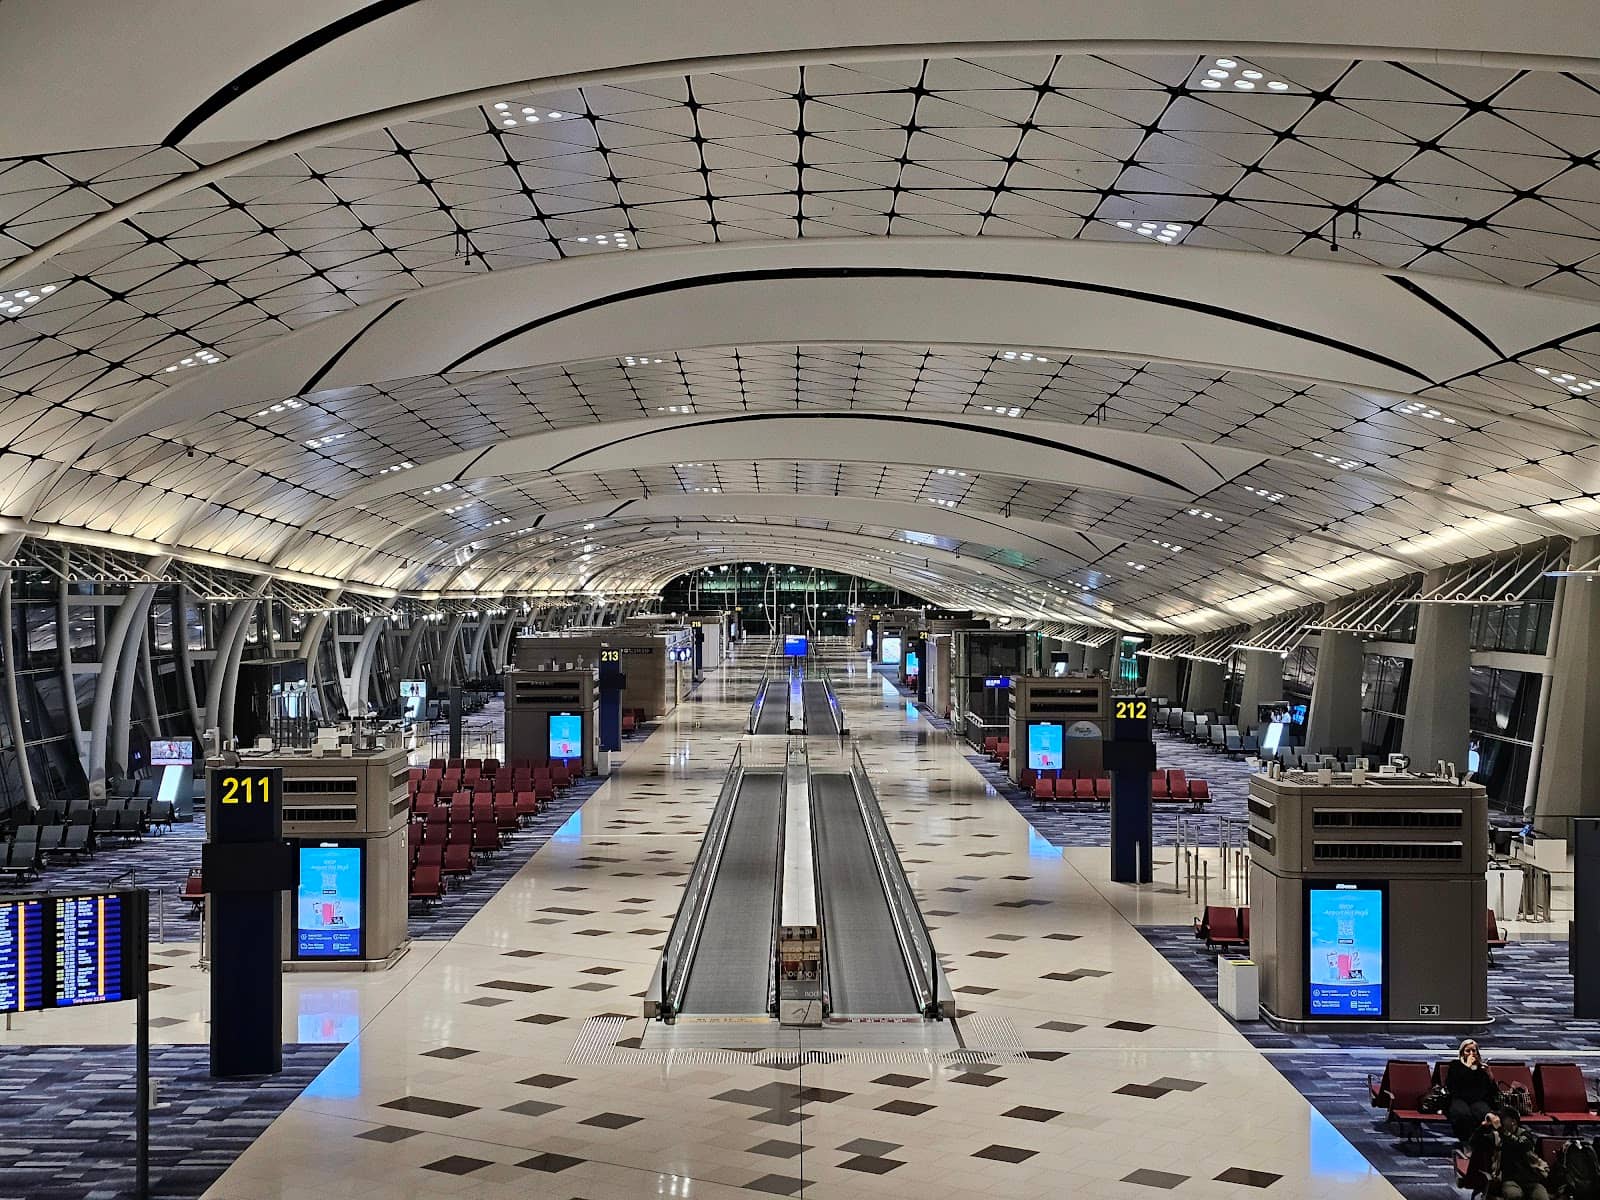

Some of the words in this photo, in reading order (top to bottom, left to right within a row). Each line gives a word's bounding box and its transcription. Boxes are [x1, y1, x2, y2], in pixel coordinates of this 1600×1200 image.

[601, 651, 619, 661] 213
[1116, 702, 1147, 719] 212
[222, 776, 269, 803] 211
